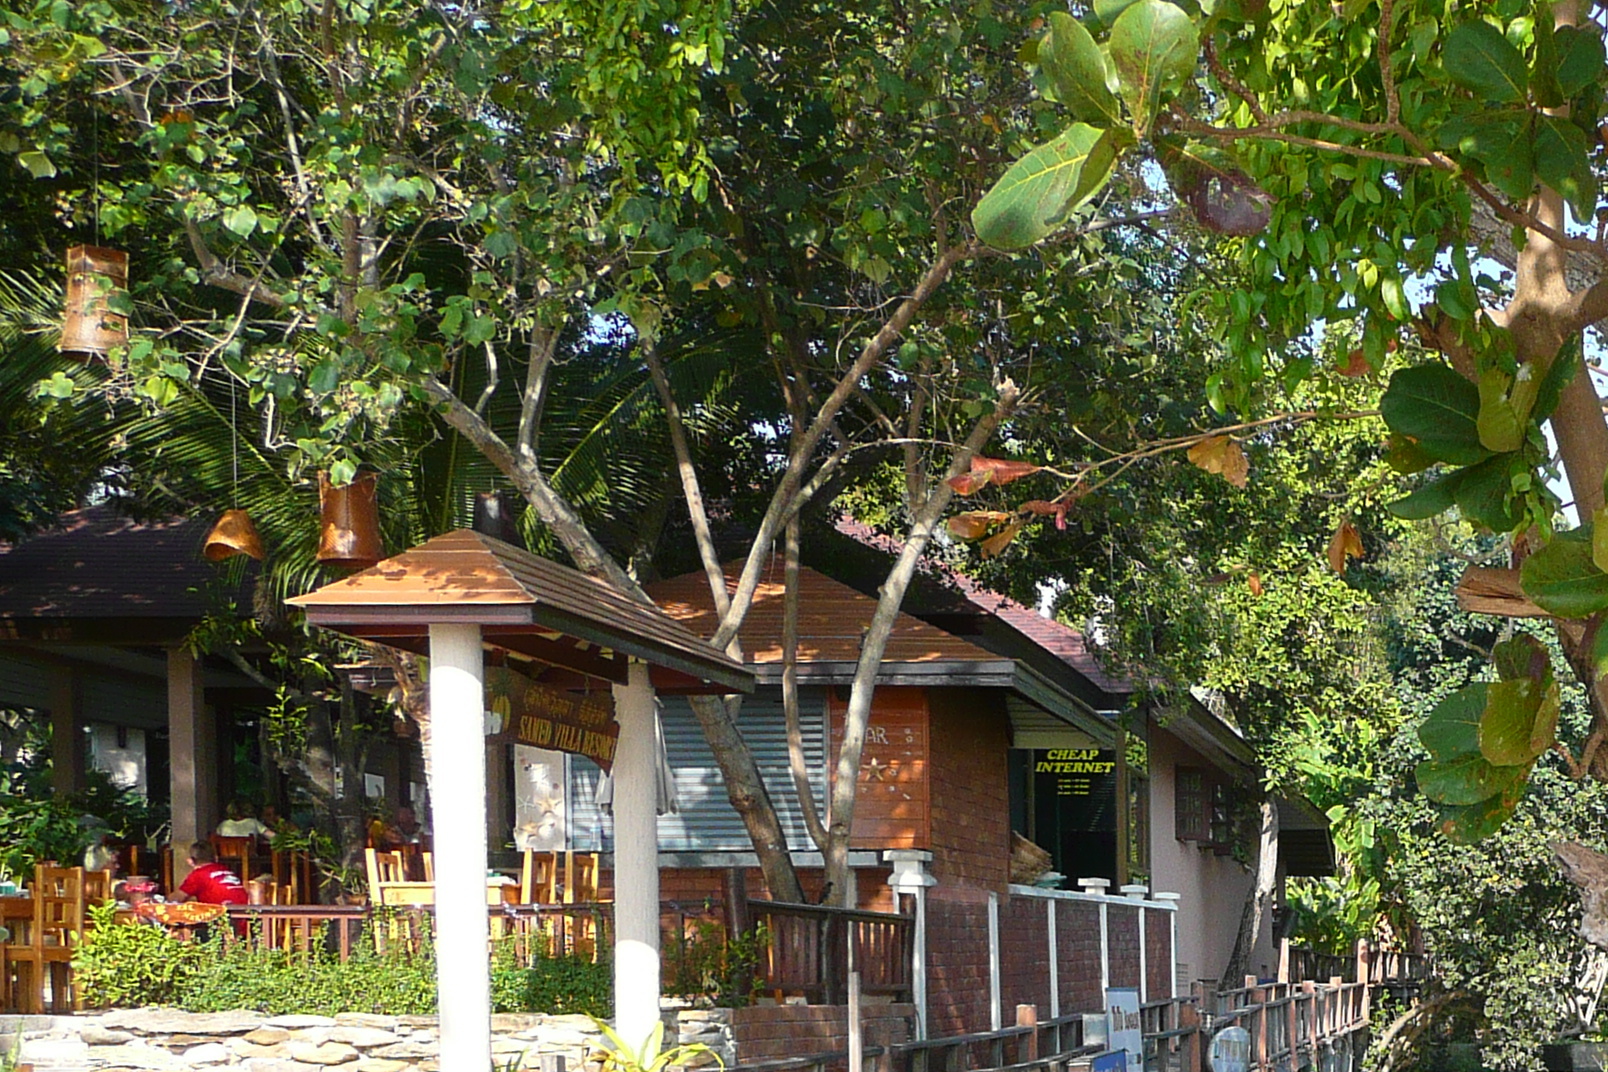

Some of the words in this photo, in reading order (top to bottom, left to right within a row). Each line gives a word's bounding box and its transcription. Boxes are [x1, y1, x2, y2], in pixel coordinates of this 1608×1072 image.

[518, 715, 553, 746] SAMED
[554, 723, 582, 753] VILLA
[582, 730, 618, 761] RESORT
[1046, 749, 1100, 761] CHEAP
[1035, 761, 1115, 773] INTERNET
